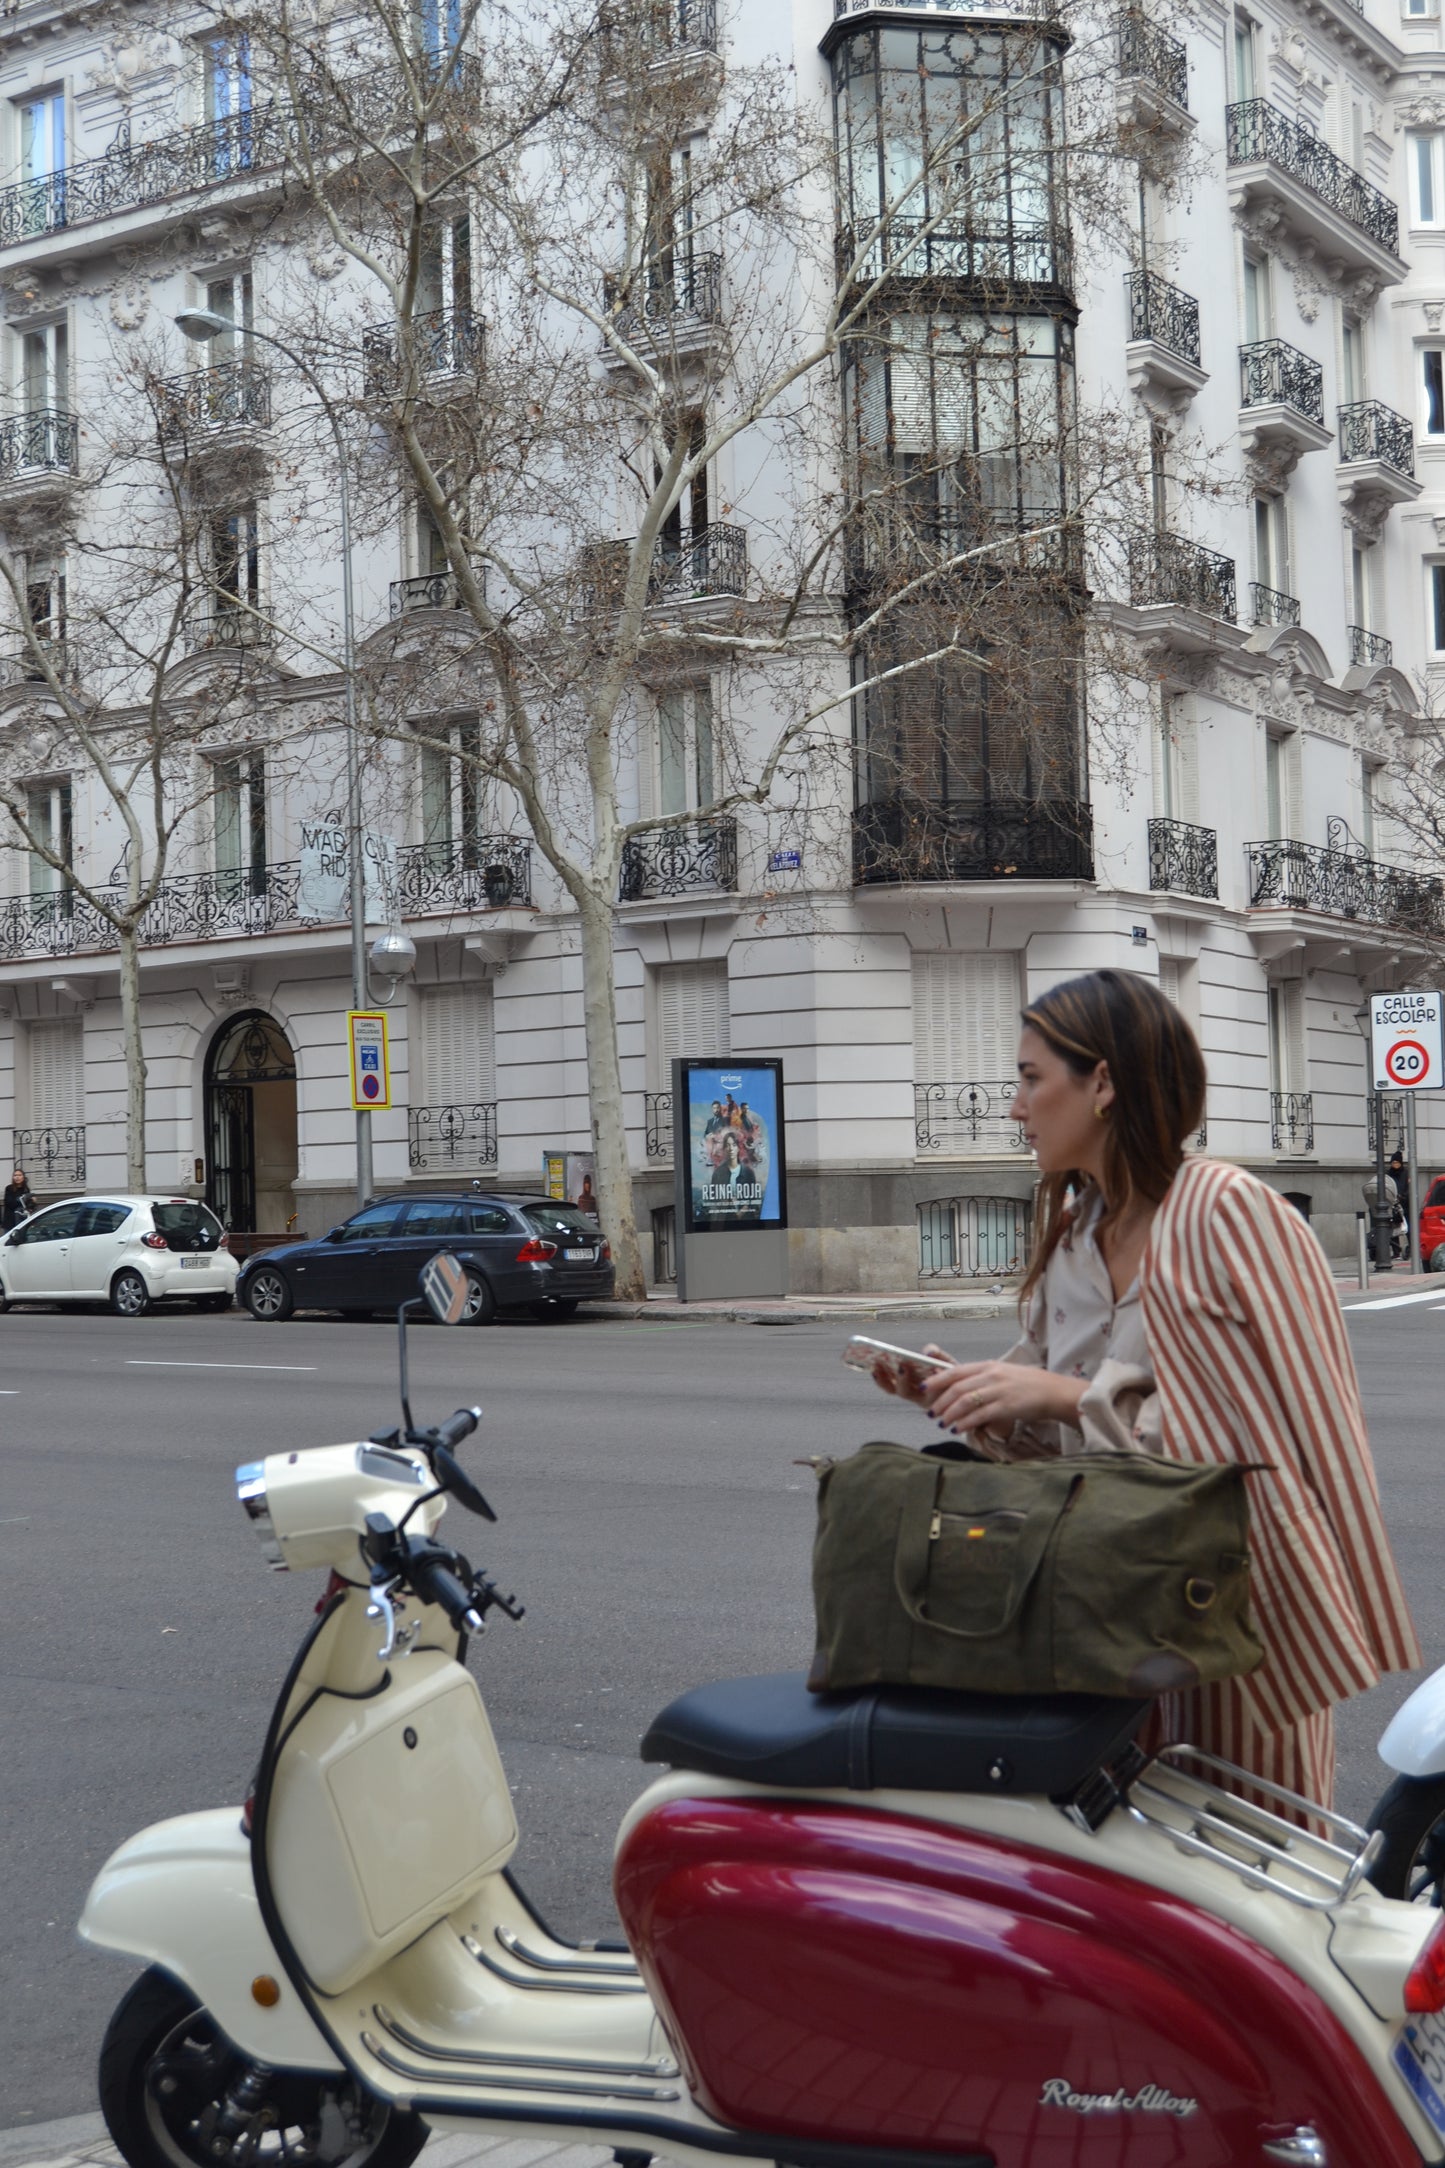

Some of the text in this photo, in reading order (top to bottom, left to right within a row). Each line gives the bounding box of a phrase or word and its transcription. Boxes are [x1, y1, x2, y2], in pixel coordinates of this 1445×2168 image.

[302, 827, 346, 853] MAD
[320, 854, 347, 878] RID
[1375, 1009, 1436, 1024] ESCOLAR
[1395, 1055, 1419, 1070] 20
[720, 1074, 742, 1083] prime
[702, 1183, 762, 1200] REINA ROJA
[1039, 2078, 1198, 2116] Royal Alloy
